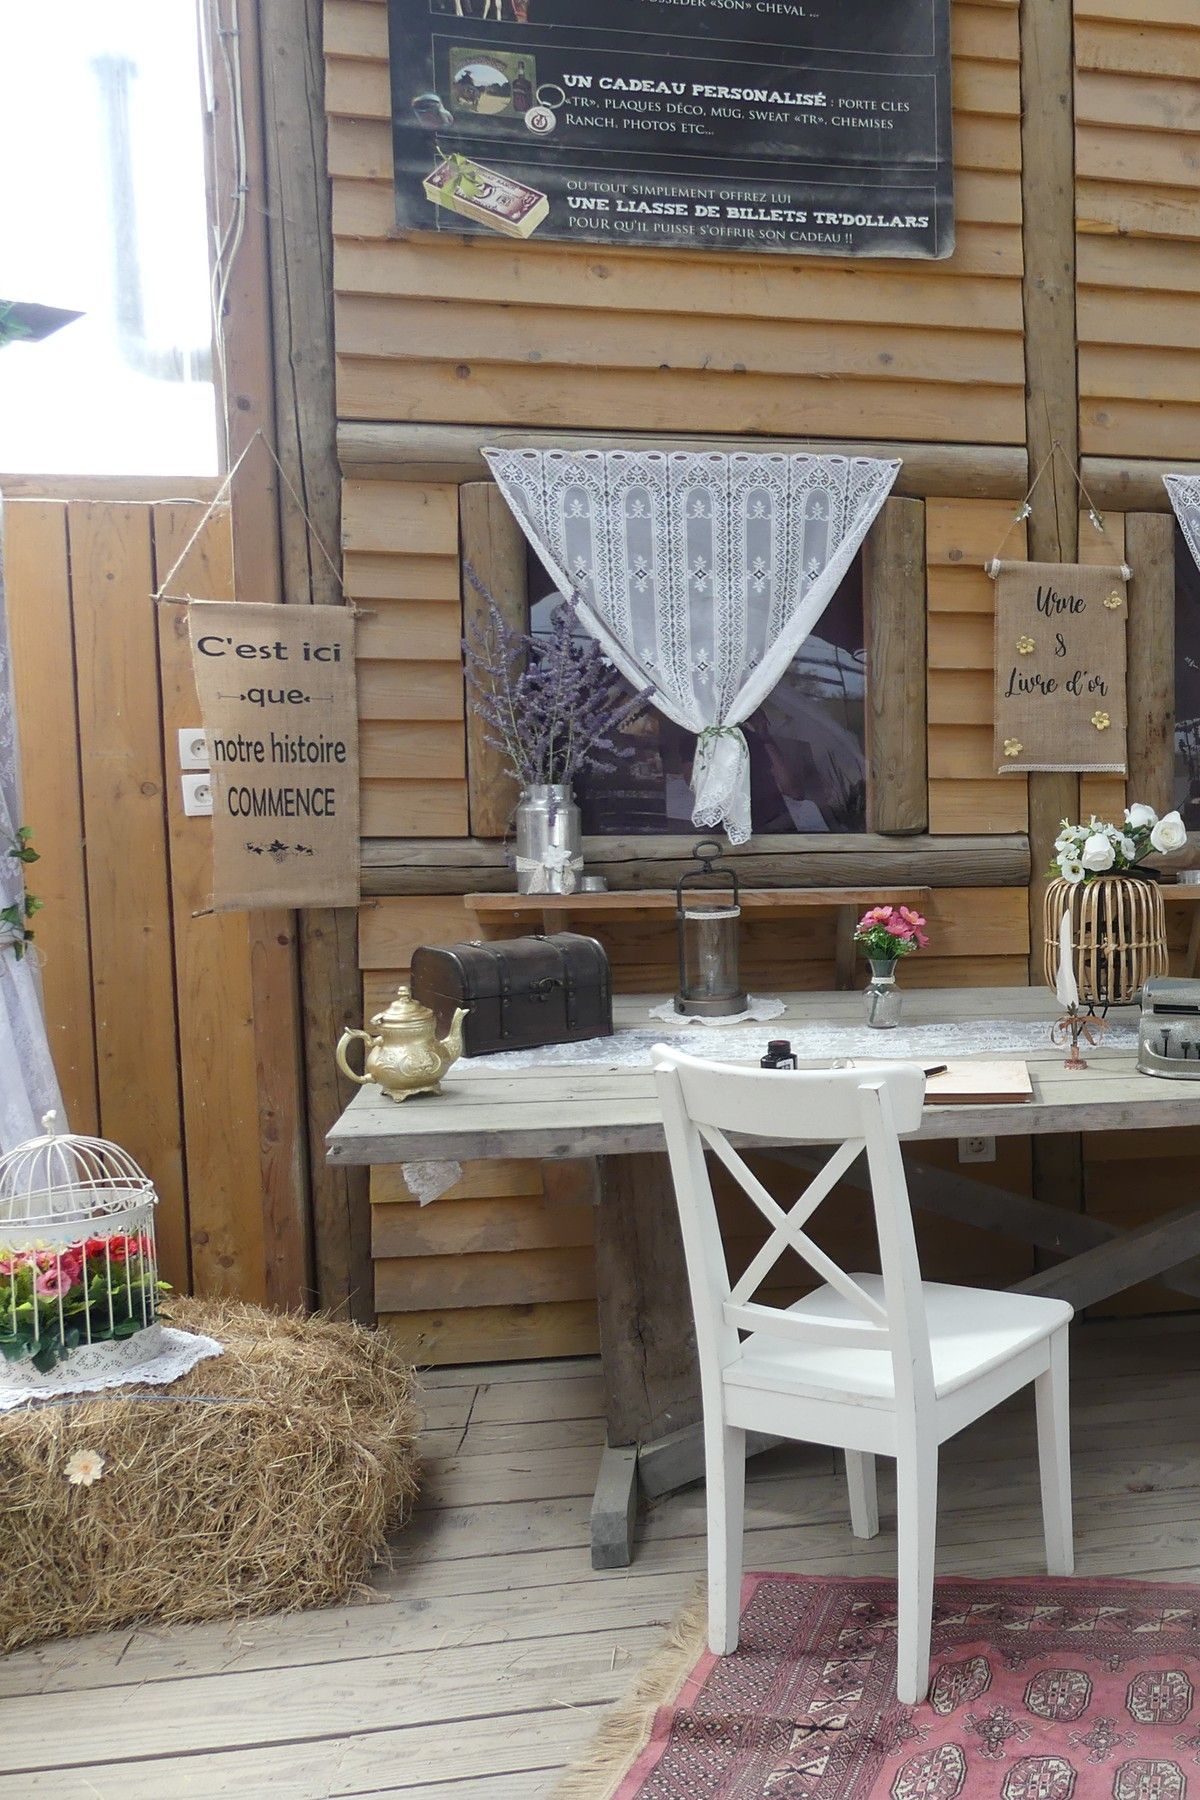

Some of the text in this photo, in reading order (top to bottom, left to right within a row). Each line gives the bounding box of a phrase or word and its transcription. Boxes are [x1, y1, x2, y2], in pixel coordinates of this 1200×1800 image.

[756, 2, 806, 17] CHEVAL
[563, 74, 592, 88] UN
[599, 77, 686, 95] CADEAU
[692, 84, 826, 107] PERSONALISÉ
[838, 99, 878, 111] PORTE
[605, 98, 661, 113] PLAQUES
[666, 101, 707, 116] DÉCO,
[711, 106, 745, 120] MUG,
[749, 109, 790, 123] SWEAT
[831, 116, 894, 130] CHEMISES
[623, 119, 676, 132] PHOTOS
[567, 180, 791, 204] OU TOUT SIMPLEMENT OFFREZ LUI
[567, 196, 930, 228] UNE LIASSE DE BILLETS TR'DOLLARS
[569, 216, 610, 230] POUR
[614, 220, 650, 233] QU'IL
[653, 222, 696, 236] PUISSE
[700, 224, 755, 239] S'OFFRIR
[759, 229, 786, 240] SON
[790, 231, 841, 243] CADEAU
[1036, 585, 1087, 618] Urne
[197, 635, 342, 662] C'est ici
[247, 687, 305, 708] que
[1004, 667, 1109, 698] Livre d'or
[214, 732, 346, 764] notre histoire
[227, 786, 336, 818] COMMENCE
